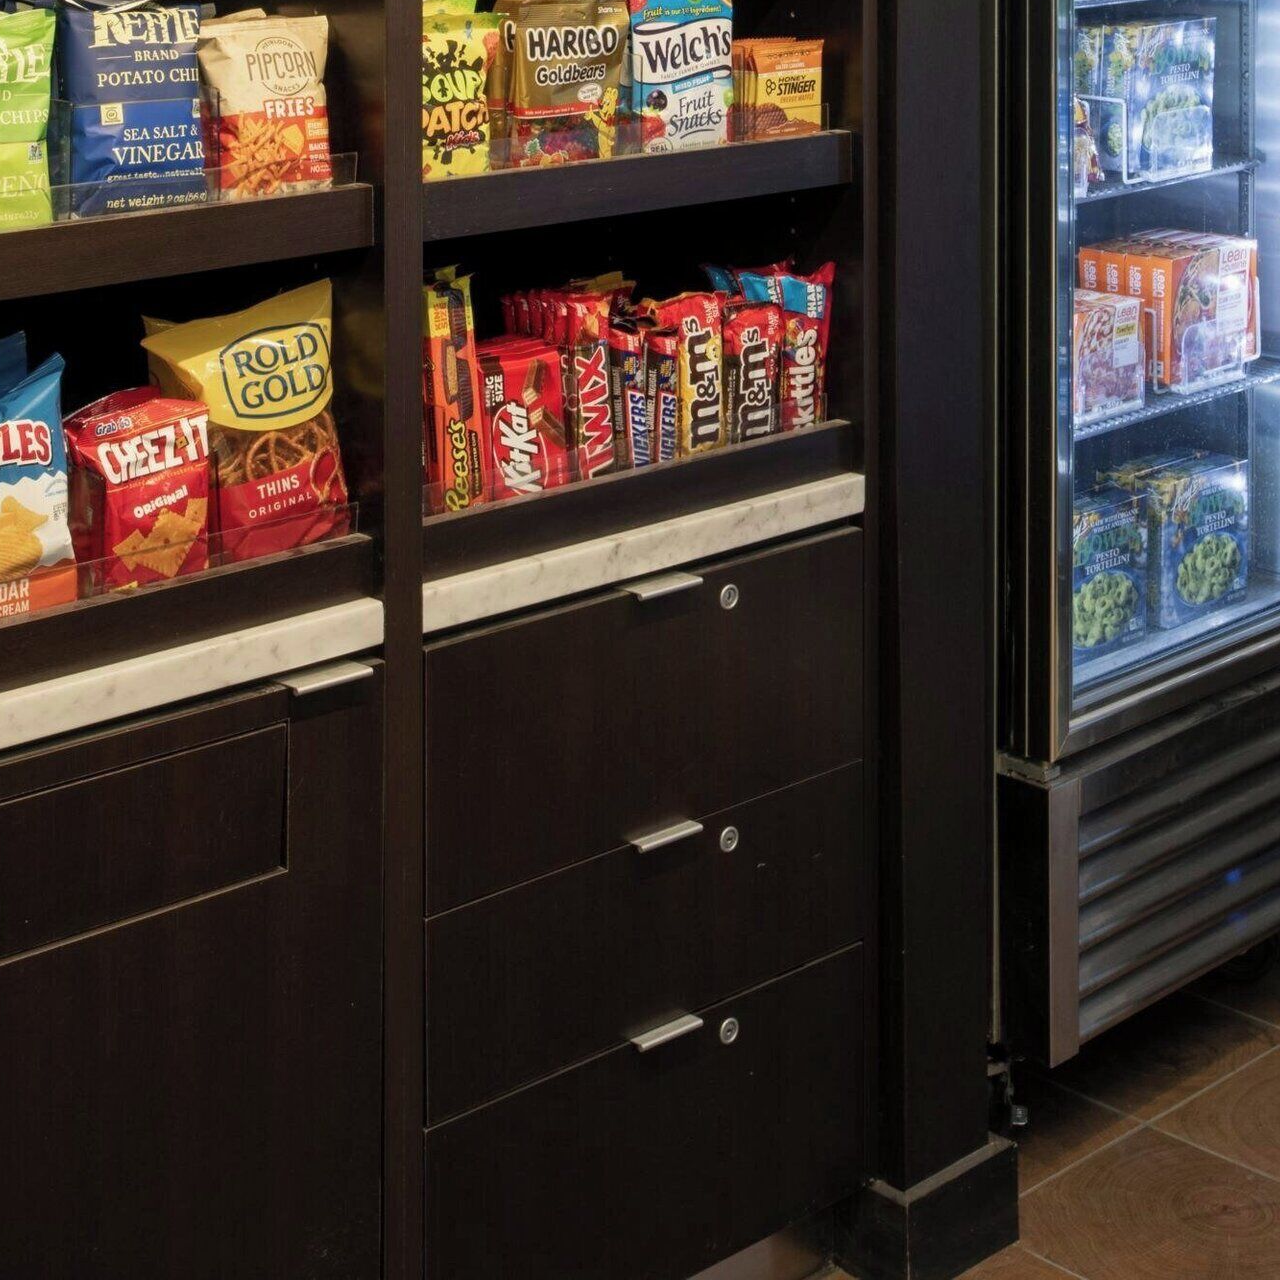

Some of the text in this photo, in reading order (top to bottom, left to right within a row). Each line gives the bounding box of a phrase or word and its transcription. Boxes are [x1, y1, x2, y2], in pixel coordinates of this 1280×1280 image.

[528, 26, 618, 59] HARIBO
[640, 24, 731, 74] Welch's
[134, 50, 179, 62] BRAND
[245, 51, 318, 82] PIPCORN
[97, 69, 166, 88] POTATO
[536, 64, 605, 85] Goldbears
[1159, 70, 1200, 85] TORTELLINI
[1169, 63, 1192, 76] PESTO
[777, 80, 816, 96] STINGER
[264, 97, 314, 119] FRIES
[679, 90, 714, 116] Fruit
[0, 109, 48, 126] CHIPS
[668, 107, 722, 137] Snacks
[124, 124, 198, 142] SEA SALT &
[112, 140, 205, 166] VINEGAR
[129, 194, 164, 207] weight
[232, 332, 318, 378] ROLD
[241, 363, 326, 409] GOLD
[97, 414, 208, 484] CHEEZ-IT
[445, 419, 469, 511] Reese's
[257, 474, 300, 498] THINS
[249, 492, 312, 518] ORIGINAL
[1085, 553, 1130, 575] TORTELLINI
[1095, 548, 1120, 563] PESTO
